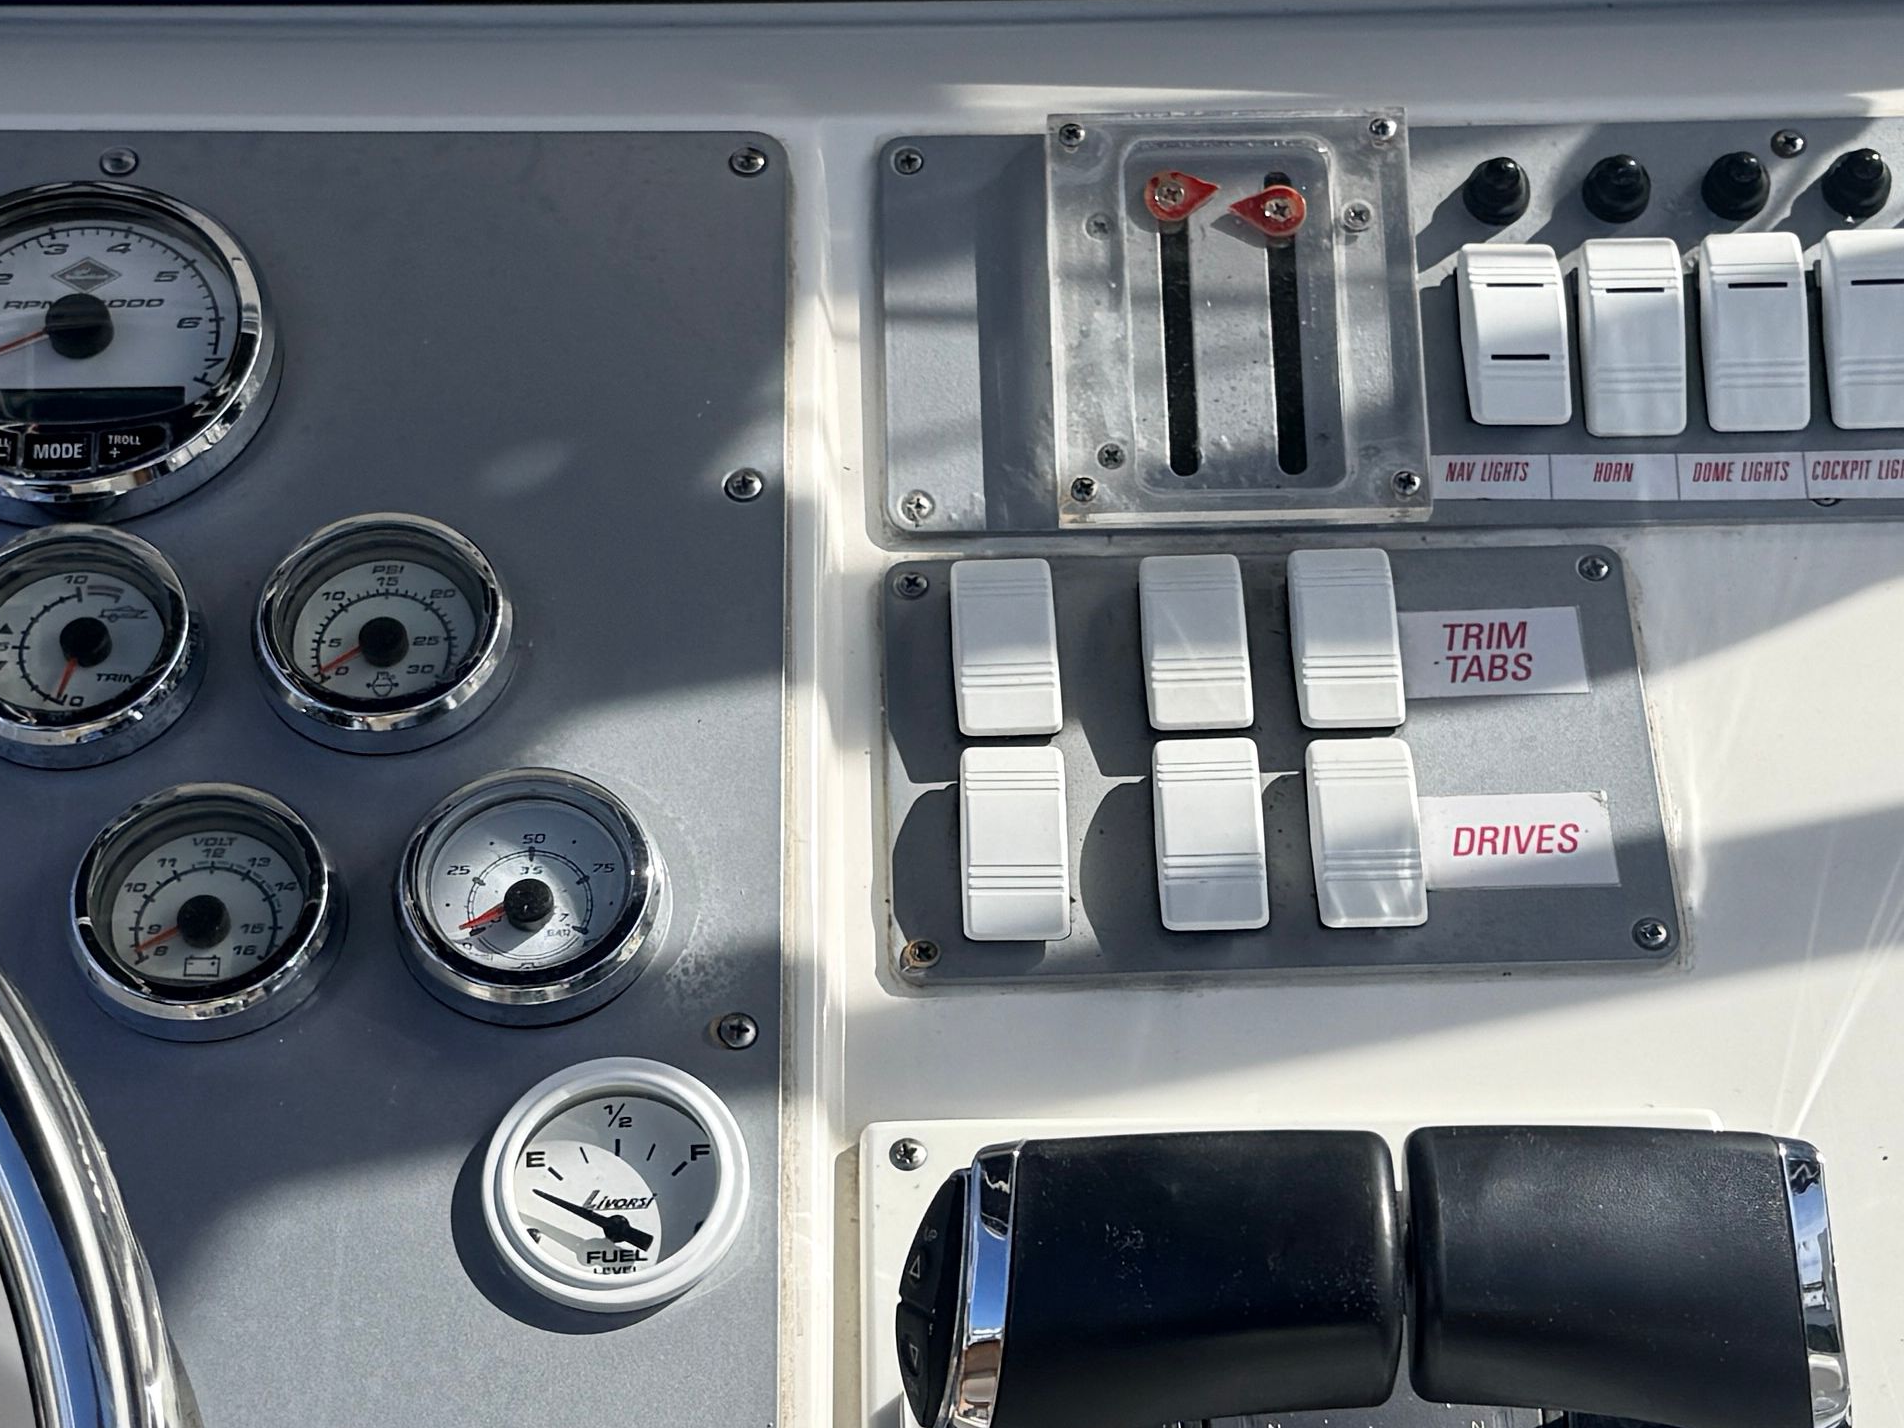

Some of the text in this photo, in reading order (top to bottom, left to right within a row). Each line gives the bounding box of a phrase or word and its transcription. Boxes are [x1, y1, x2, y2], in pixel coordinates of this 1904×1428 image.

[43, 242, 70, 255] 3
[107, 242, 132, 254] 4
[153, 271, 179, 283] 5
[176, 316, 203, 329] 6
[108, 434, 141, 446] TROLL
[33, 443, 82, 460] MODE
[1445, 460, 1528, 482] NAV LIGHTS
[1593, 461, 1634, 482] HORN
[1693, 460, 1790, 482] DOME LIGHTS
[1812, 460, 1873, 481] COCKPIT
[372, 564, 405, 575] PSI
[63, 575, 89, 585] 10
[376, 576, 399, 587] 15
[322, 591, 346, 601] 10
[430, 588, 457, 599] 20
[412, 636, 440, 646] 25
[1442, 620, 1528, 651] TRIM
[328, 638, 342, 648] 5
[335, 666, 350, 676] 0
[406, 664, 435, 674] 30
[1445, 653, 1533, 684] TABS
[192, 837, 238, 847] VOLT
[522, 833, 546, 845] 50
[1453, 823, 1580, 856] DRIVES
[202, 848, 226, 859] 12
[157, 858, 178, 868] 11
[247, 857, 271, 868] 13
[593, 863, 615, 873] 75
[447, 865, 471, 876] 25
[124, 882, 147, 893] 10
[274, 882, 298, 892] 14
[147, 924, 162, 934] 9
[240, 924, 264, 934] 15
[233, 945, 257, 955] 16
[603, 1103, 633, 1128] 1/2
[690, 1144, 711, 1162] F
[526, 1151, 546, 1168] E
[586, 1250, 648, 1264] FUEL
